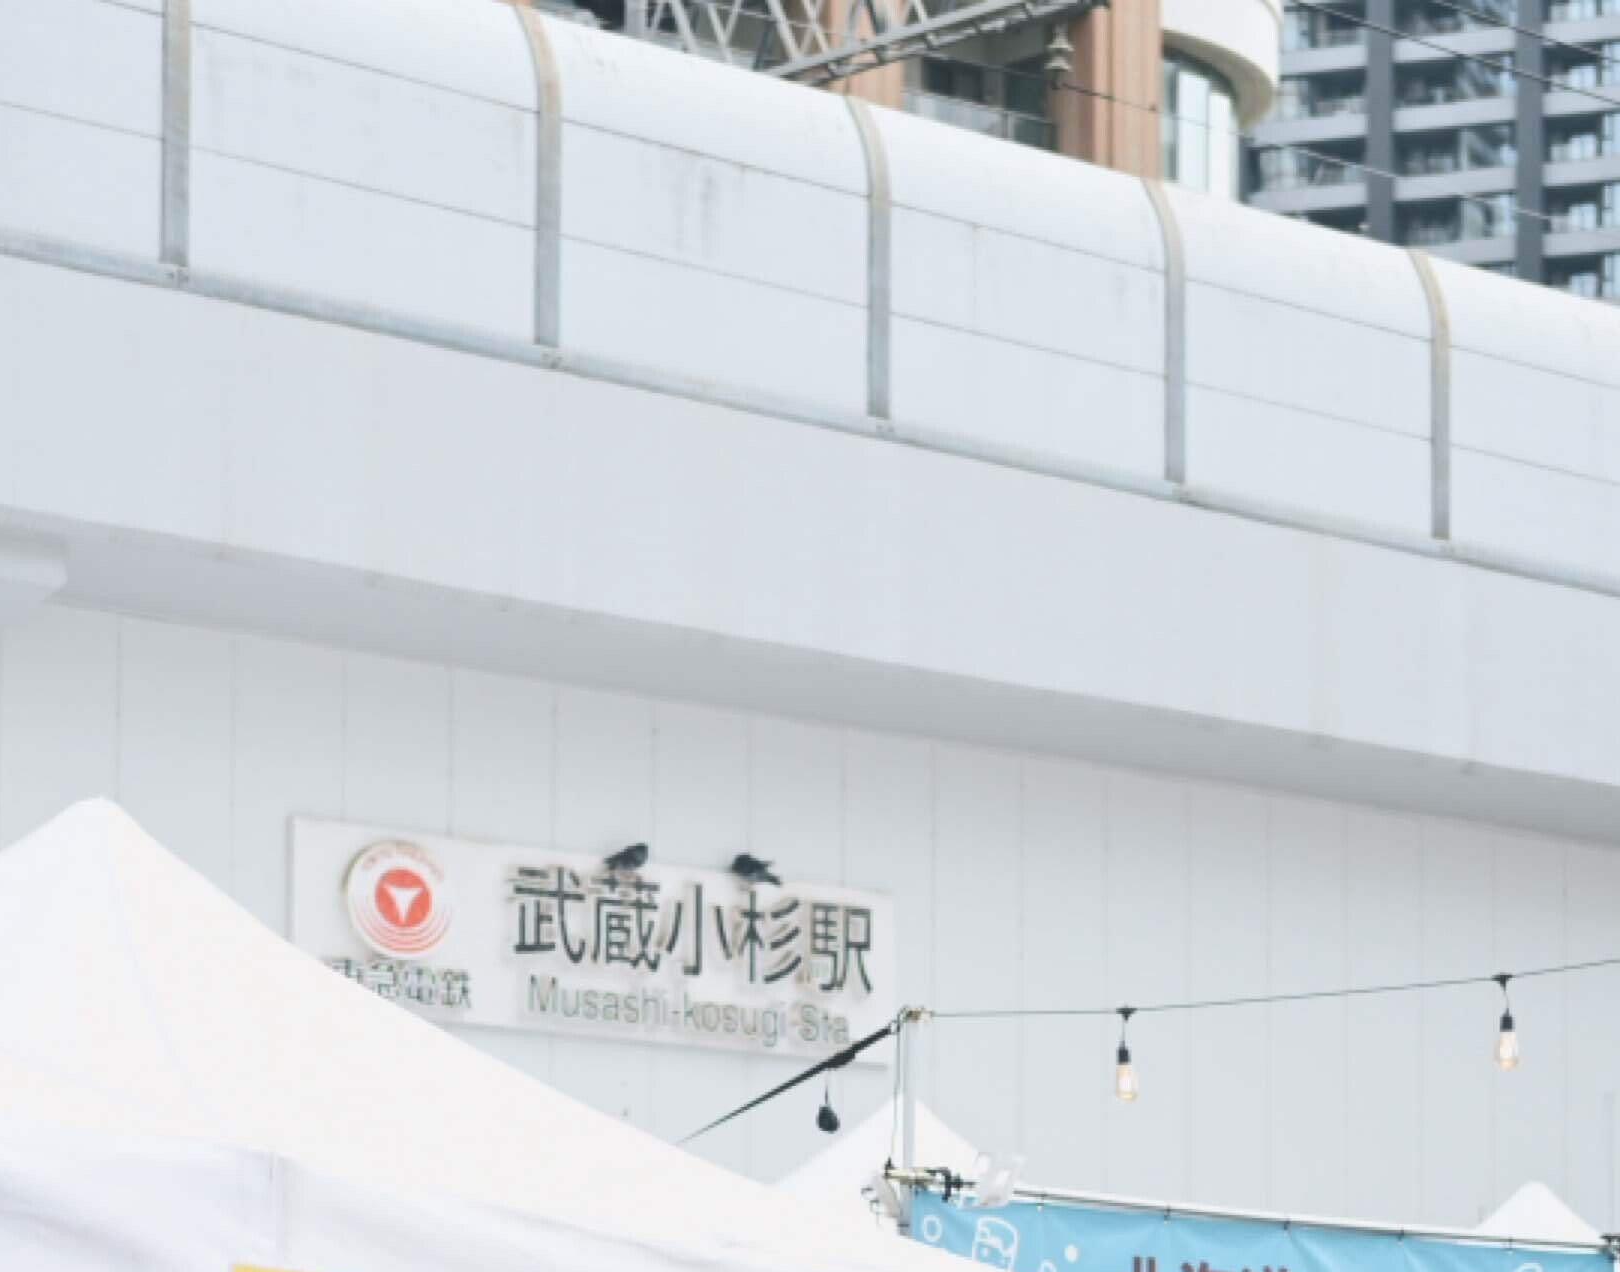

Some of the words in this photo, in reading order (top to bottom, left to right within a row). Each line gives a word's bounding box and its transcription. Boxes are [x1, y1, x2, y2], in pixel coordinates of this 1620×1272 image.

[512, 866, 874, 994] 武蔵小杉駅
[527, 974, 788, 1047] Musashi-kosugi
